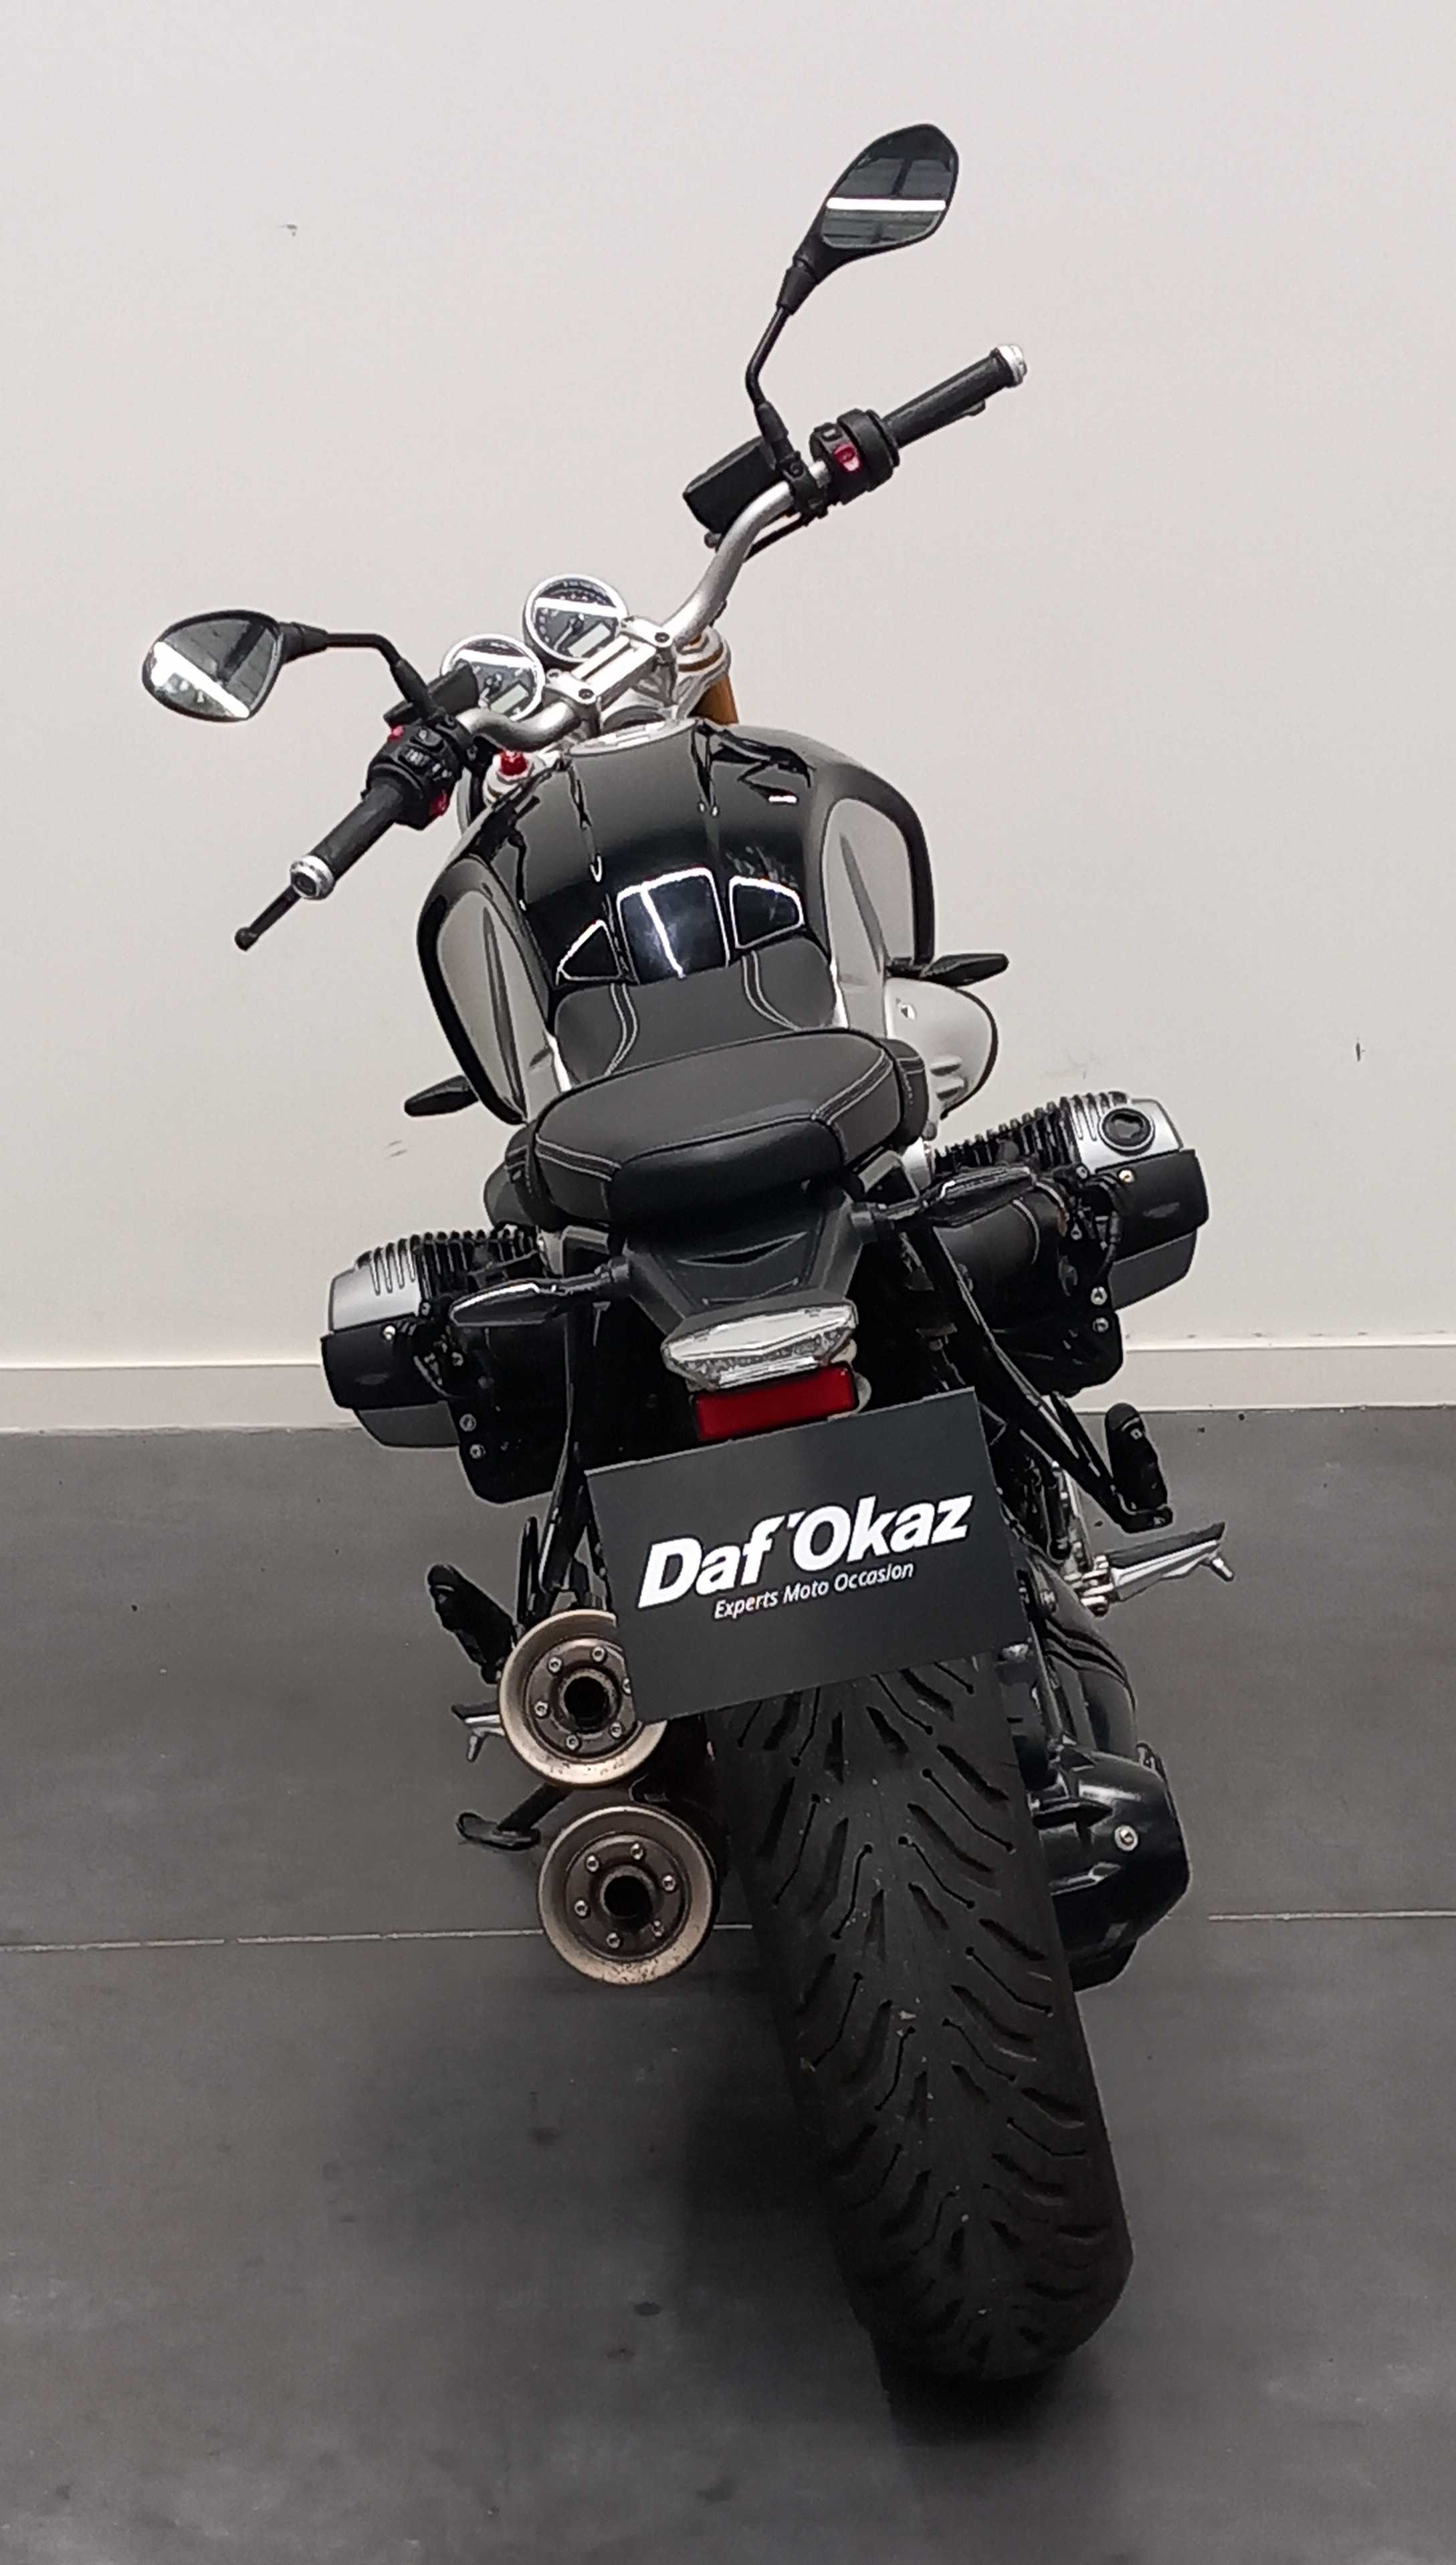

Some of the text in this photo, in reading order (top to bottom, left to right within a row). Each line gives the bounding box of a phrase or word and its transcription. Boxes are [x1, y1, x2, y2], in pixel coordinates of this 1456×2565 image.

[714, 1562, 914, 1619] Experts Moto Occasion
